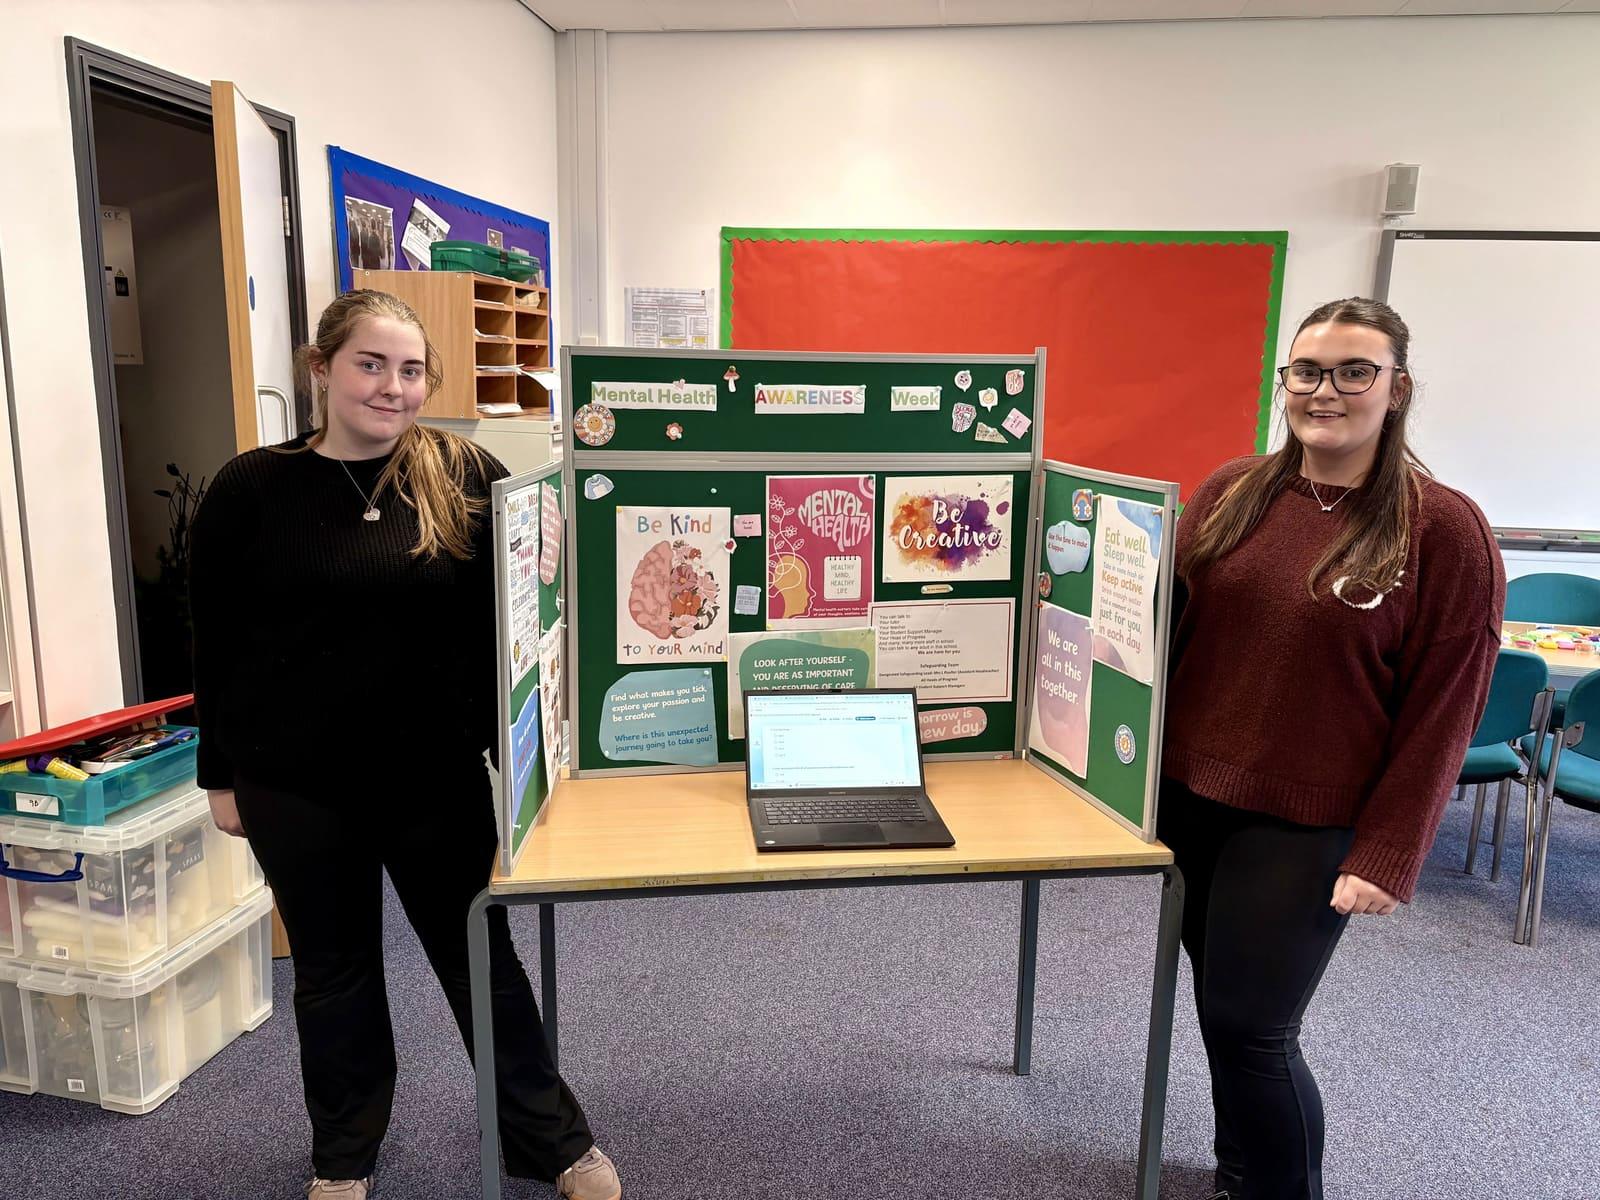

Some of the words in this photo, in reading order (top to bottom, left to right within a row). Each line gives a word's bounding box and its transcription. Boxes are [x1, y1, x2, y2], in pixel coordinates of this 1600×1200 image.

[592, 386, 654, 403] Mental
[658, 388, 716, 405] Health
[756, 390, 864, 405] AWARENESS
[892, 391, 939, 406] Week
[798, 489, 868, 528] MENTAL
[932, 500, 964, 524] Be
[638, 516, 662, 533] Be
[670, 514, 712, 536] Kind
[812, 514, 870, 552] HEALTH
[899, 522, 1002, 550] Creative
[1105, 527, 1120, 546] Eat
[1124, 536, 1147, 554] well.
[1104, 544, 1125, 566] Sleep
[1102, 569, 1118, 589] Keep
[1100, 605, 1112, 622] just
[1114, 612, 1126, 625] for
[1048, 629, 1060, 648] We
[1062, 640, 1078, 655] are
[1099, 624, 1105, 635] in
[1107, 627, 1124, 642] each
[754, 660, 776, 668] LOOK
[779, 658, 804, 666] AFTER
[806, 656, 846, 665] YOURSELF
[1042, 652, 1052, 668] all
[1054, 656, 1062, 672] in
[1064, 661, 1082, 682] this
[774, 672, 789, 680] ARE
[792, 671, 803, 679] AS
[805, 669, 854, 678] IMPORTANT
[611, 692, 626, 702] Find
[628, 691, 648, 700] what
[651, 689, 674, 697] makes
[676, 688, 690, 696] you
[1041, 674, 1079, 704] together.
[612, 704, 640, 712] explore
[642, 702, 660, 710] your
[662, 698, 690, 708] passion
[692, 694, 705, 703] and
[963, 708, 972, 718] is
[624, 712, 656, 720] creative.
[614, 734, 640, 742] Where
[667, 724, 709, 736] unexpected
[952, 720, 981, 736] day.
[615, 744, 644, 754] journey
[646, 741, 665, 750] going
[696, 735, 712, 744] you?
